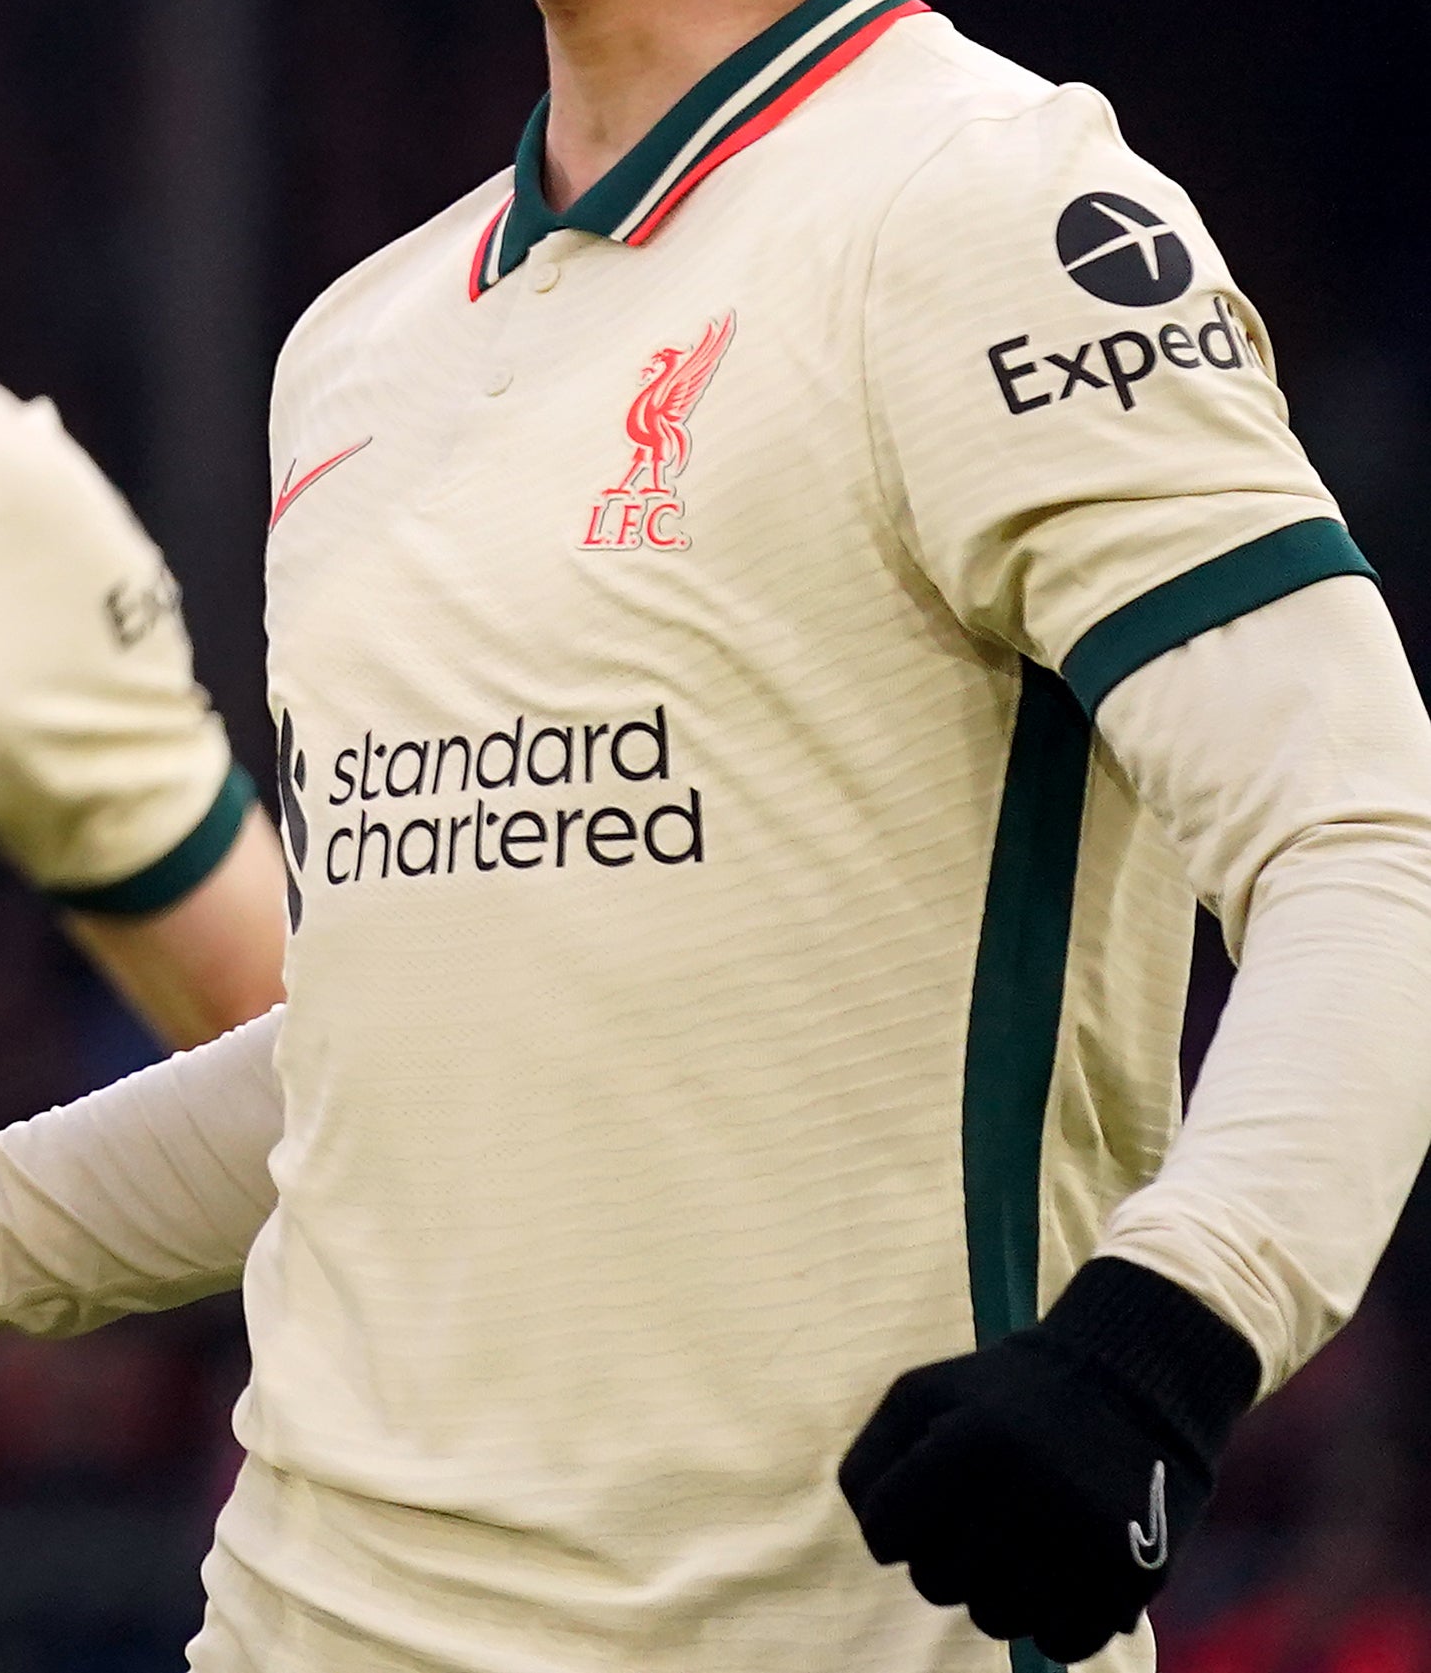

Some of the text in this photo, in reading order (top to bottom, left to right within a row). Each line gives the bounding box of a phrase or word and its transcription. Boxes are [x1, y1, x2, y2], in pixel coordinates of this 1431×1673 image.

[987, 295, 1256, 415] Exped
[328, 703, 671, 806] standard
[326, 786, 705, 886] chartered
